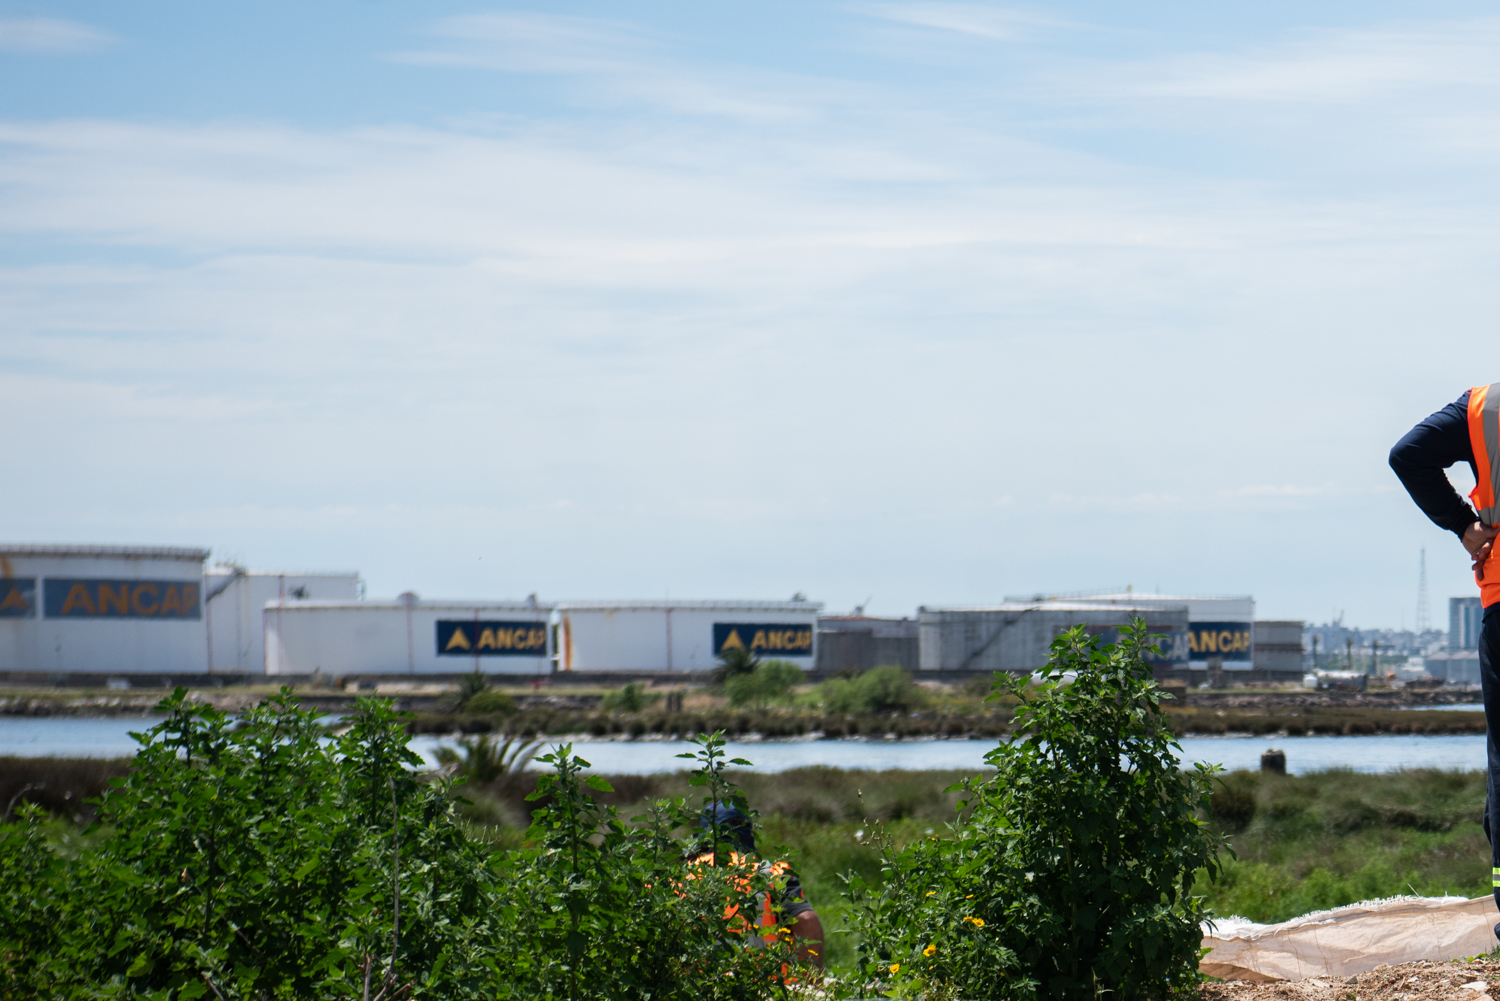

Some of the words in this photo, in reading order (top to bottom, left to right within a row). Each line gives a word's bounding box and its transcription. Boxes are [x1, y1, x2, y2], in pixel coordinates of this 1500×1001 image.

[61, 583, 197, 616] ANCAP
[477, 627, 545, 650] ANCAP
[1188, 631, 1250, 653] ANCAP
